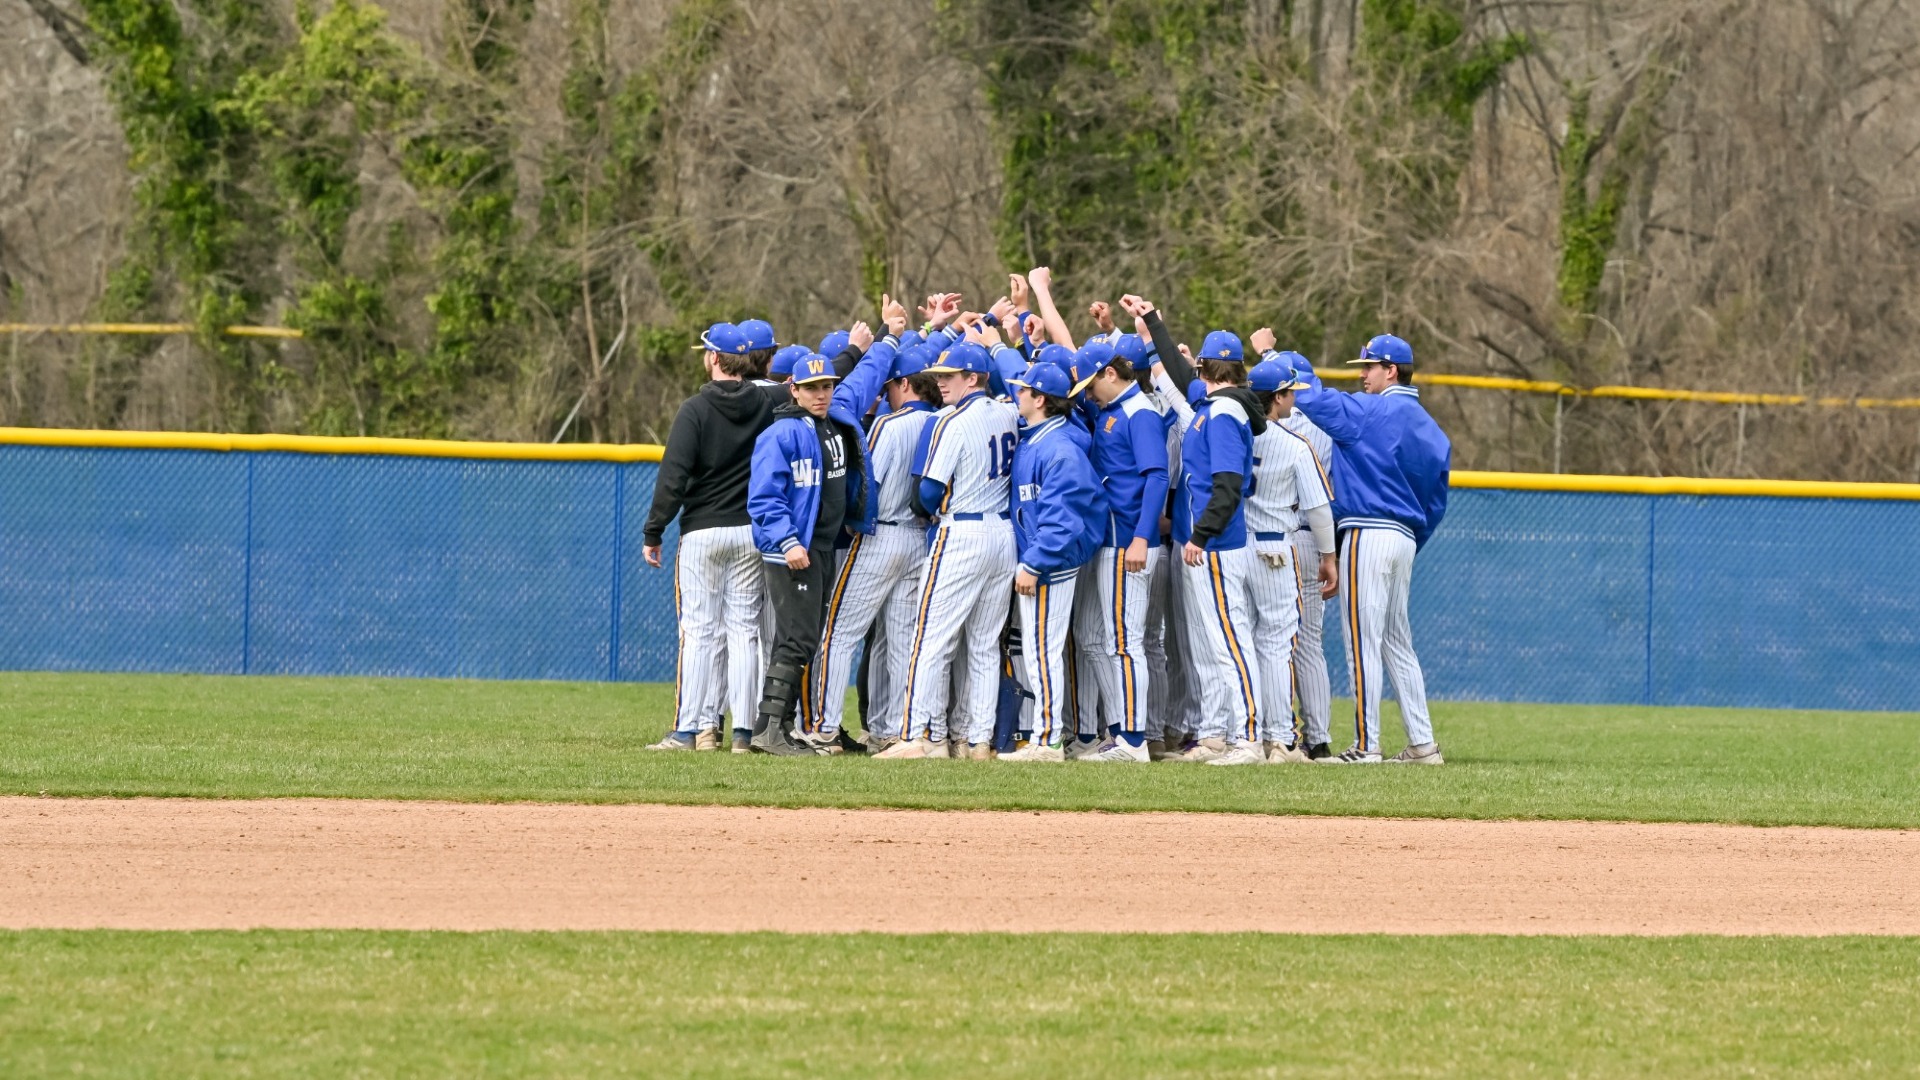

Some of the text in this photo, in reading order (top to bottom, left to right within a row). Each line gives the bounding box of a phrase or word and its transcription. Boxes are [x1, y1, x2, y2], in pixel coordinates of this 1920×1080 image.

[806, 359, 825, 375] W
[987, 431, 1016, 481] 16
[827, 466, 847, 479] BASEB
